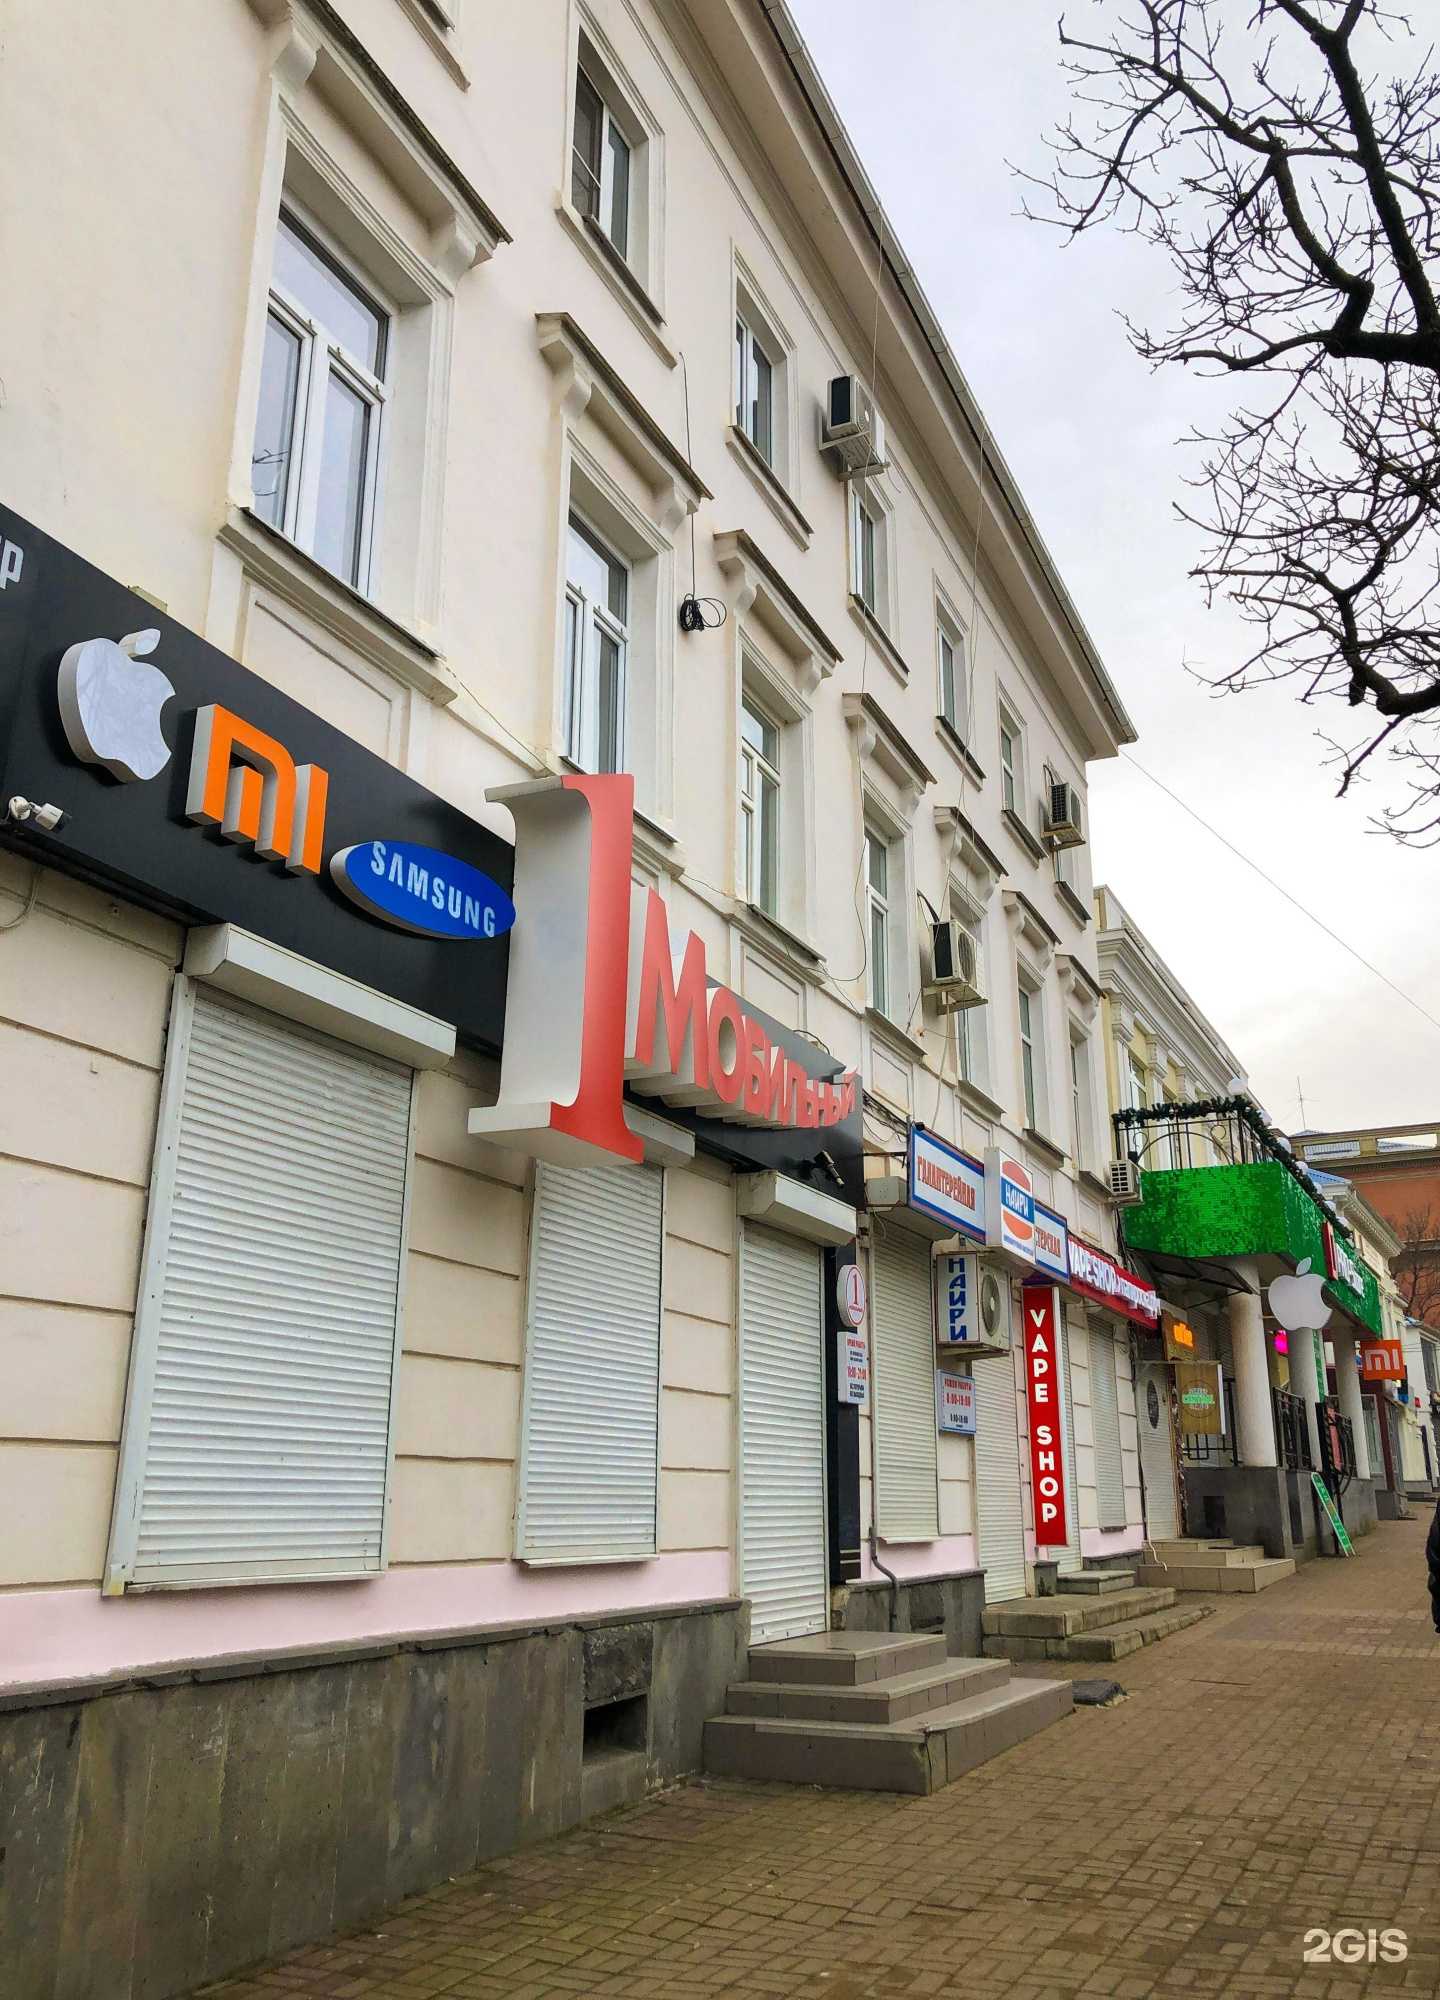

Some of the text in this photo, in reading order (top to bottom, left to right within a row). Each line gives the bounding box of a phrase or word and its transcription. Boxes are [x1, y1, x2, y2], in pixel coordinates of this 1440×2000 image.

[370, 840, 496, 938] SAMSUNG
[1005, 1183, 1029, 1218] НАИРИ
[948, 1257, 967, 1341] НАИРИ
[1030, 1308, 1059, 1524] VAPE SHOP
